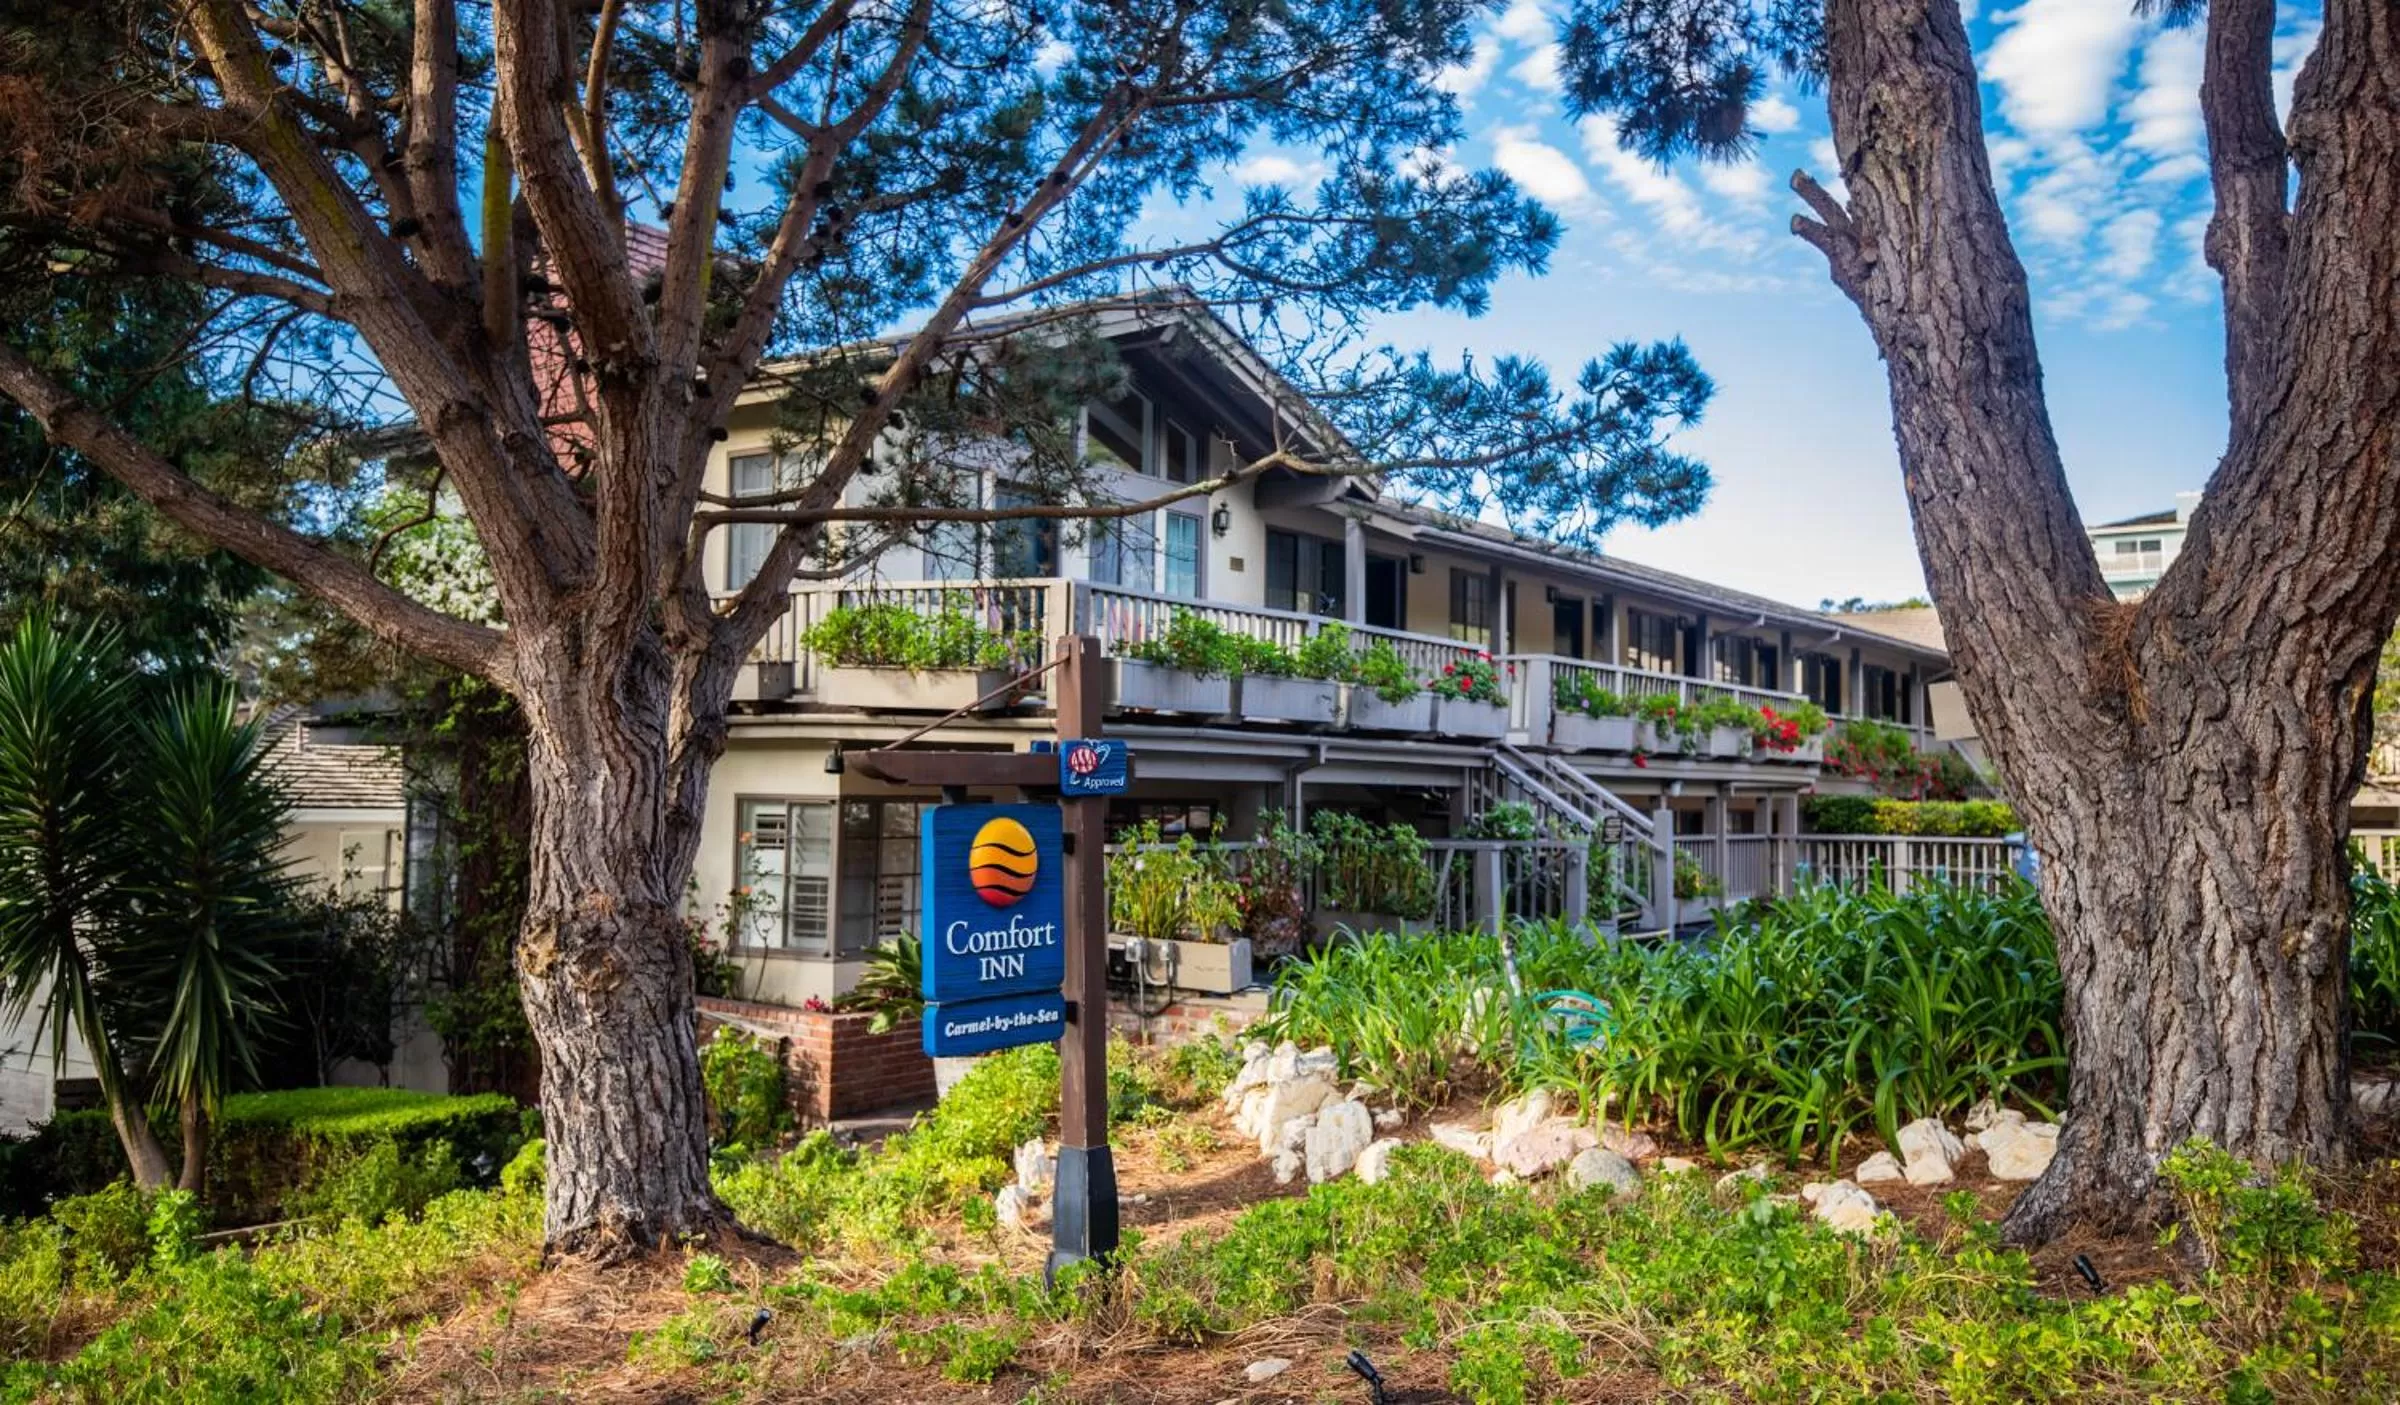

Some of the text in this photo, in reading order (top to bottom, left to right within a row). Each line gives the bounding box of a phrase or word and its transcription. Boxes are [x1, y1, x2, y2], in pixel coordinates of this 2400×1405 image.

[1083, 776, 1124, 790] Approved
[946, 914, 1056, 955] Comfort
[979, 953, 1025, 981] INN
[944, 1008, 1059, 1038] Carmel-by-the-Sea
